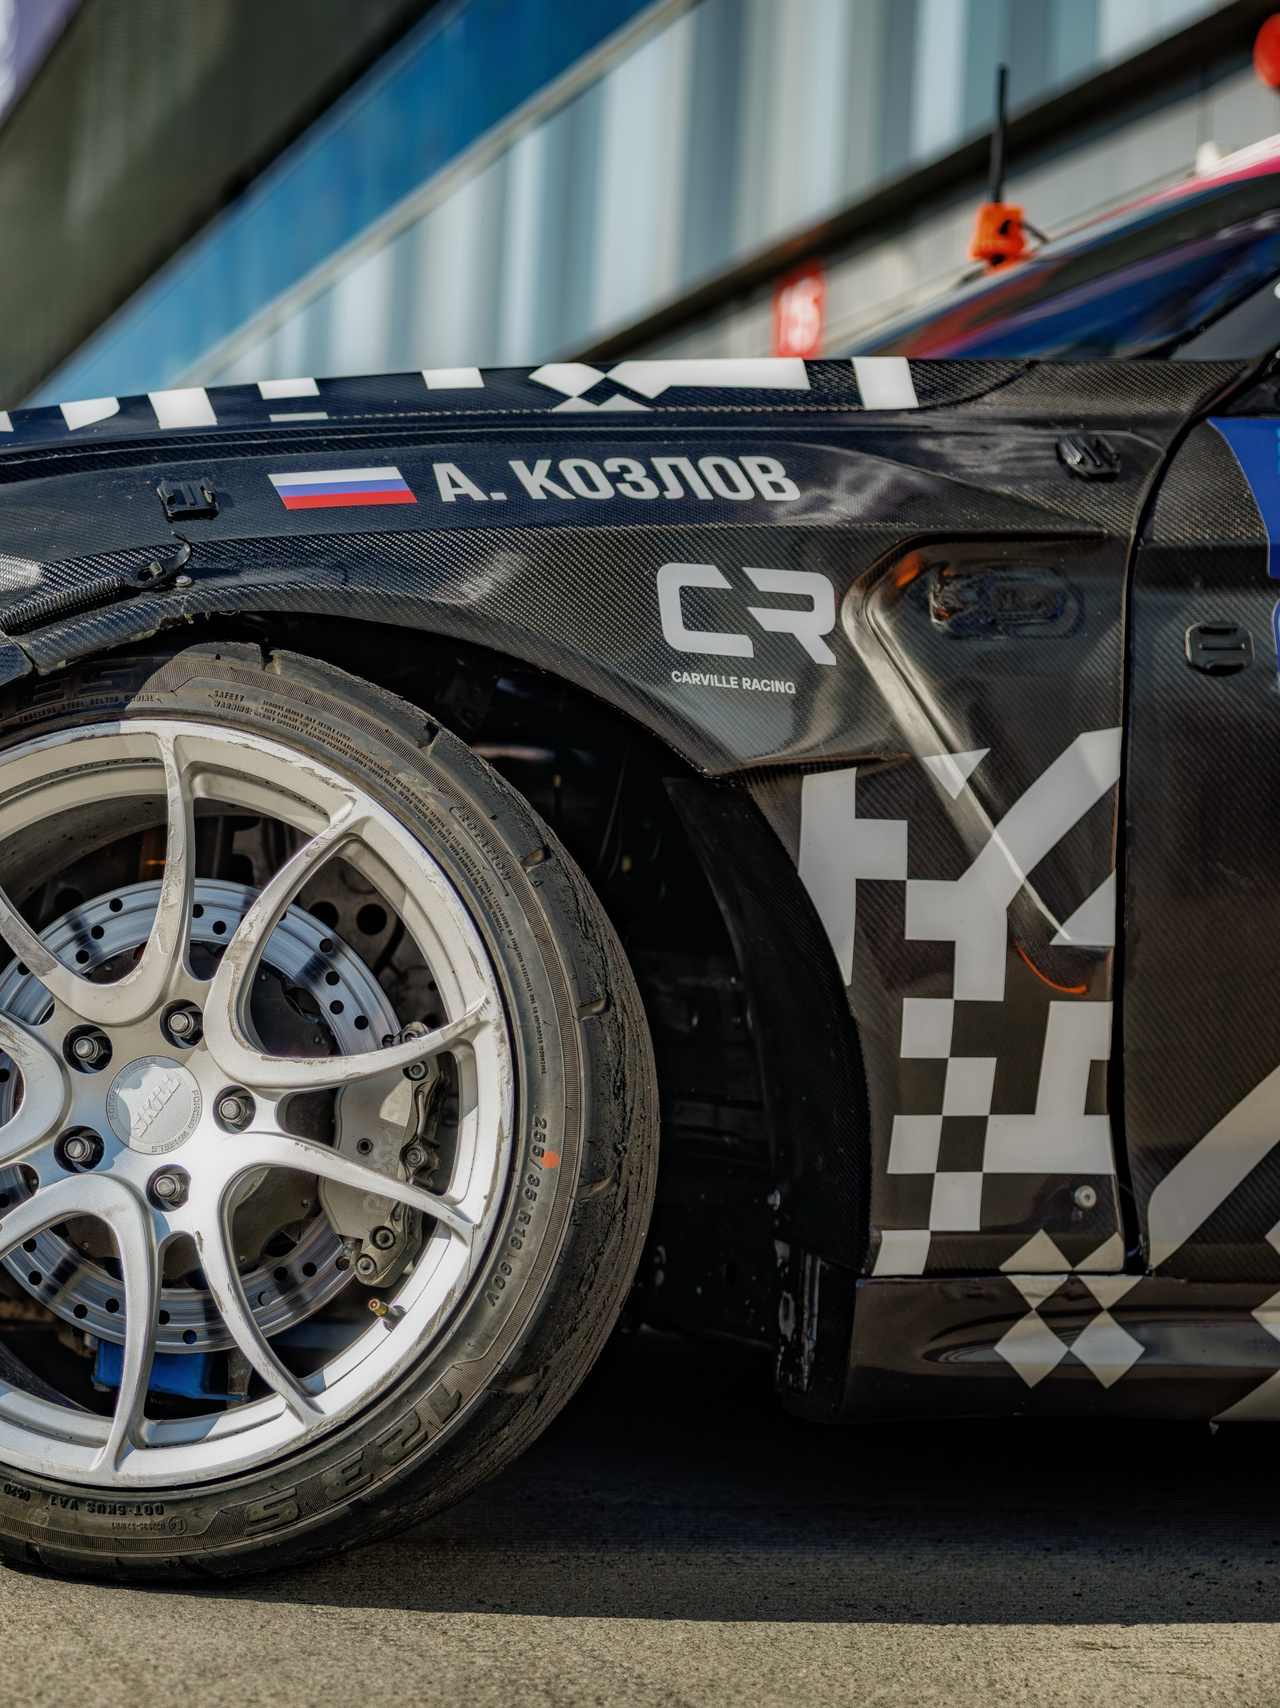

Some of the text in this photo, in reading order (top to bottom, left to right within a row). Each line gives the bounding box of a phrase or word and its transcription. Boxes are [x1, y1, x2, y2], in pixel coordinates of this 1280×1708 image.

[432, 455, 801, 502] А. КОЗЛОВ
[657, 562, 838, 666] CR
[213, 690, 244, 701] SAFETY
[671, 669, 797, 695] CARVILLE RACING
[459, 812, 511, 881] ROTATION
[525, 1116, 547, 1203] 255/35
[509, 1209, 531, 1251] R18
[134, 1503, 163, 1516] DOT
